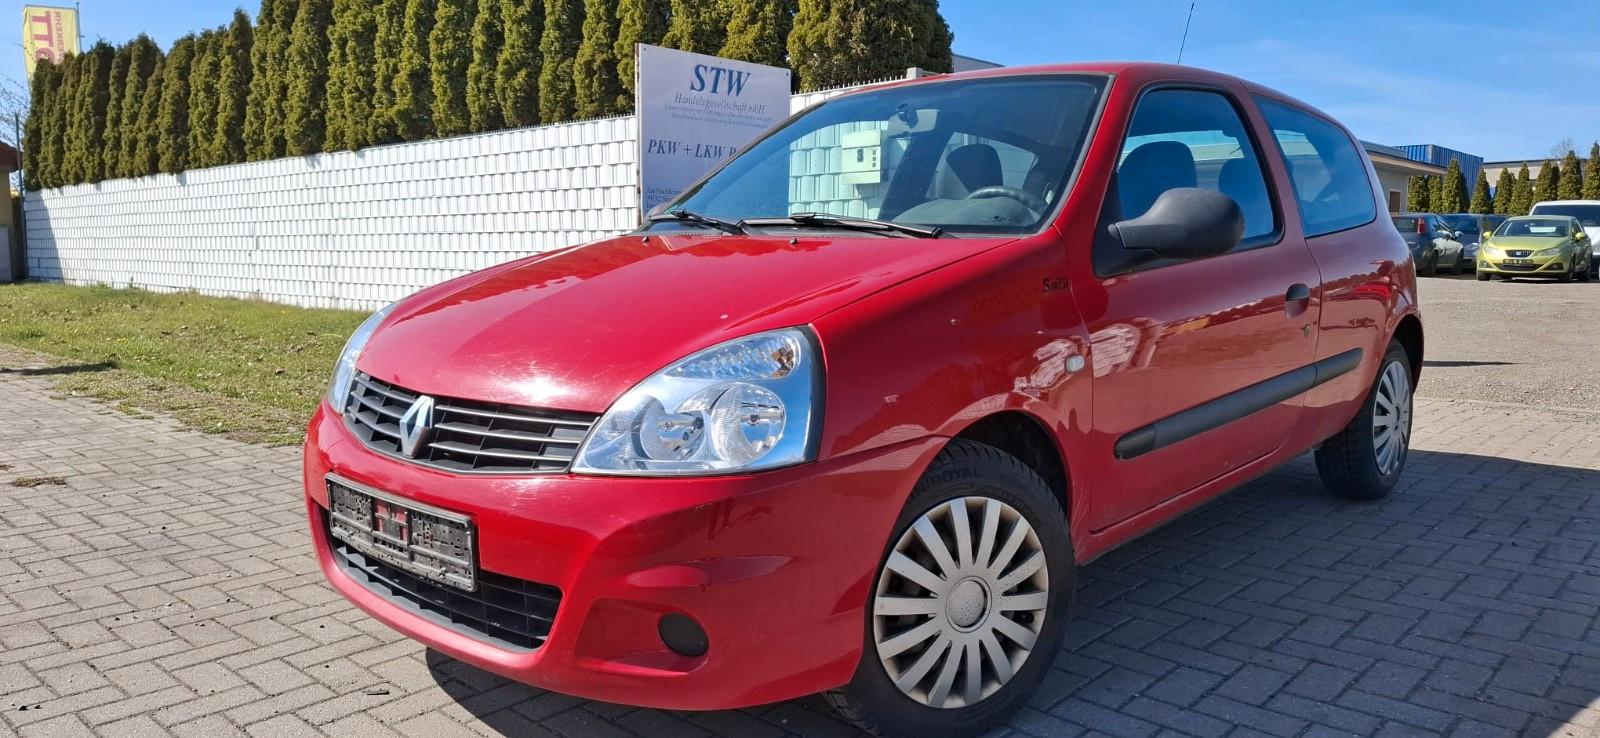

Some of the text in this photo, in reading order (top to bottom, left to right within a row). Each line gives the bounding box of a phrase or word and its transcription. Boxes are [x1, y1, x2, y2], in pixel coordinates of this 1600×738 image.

[690, 64, 752, 97] STW
[674, 93, 747, 113] Handelsgesellschaft
[648, 139, 680, 155] PKW
[695, 143, 726, 159] LKW
